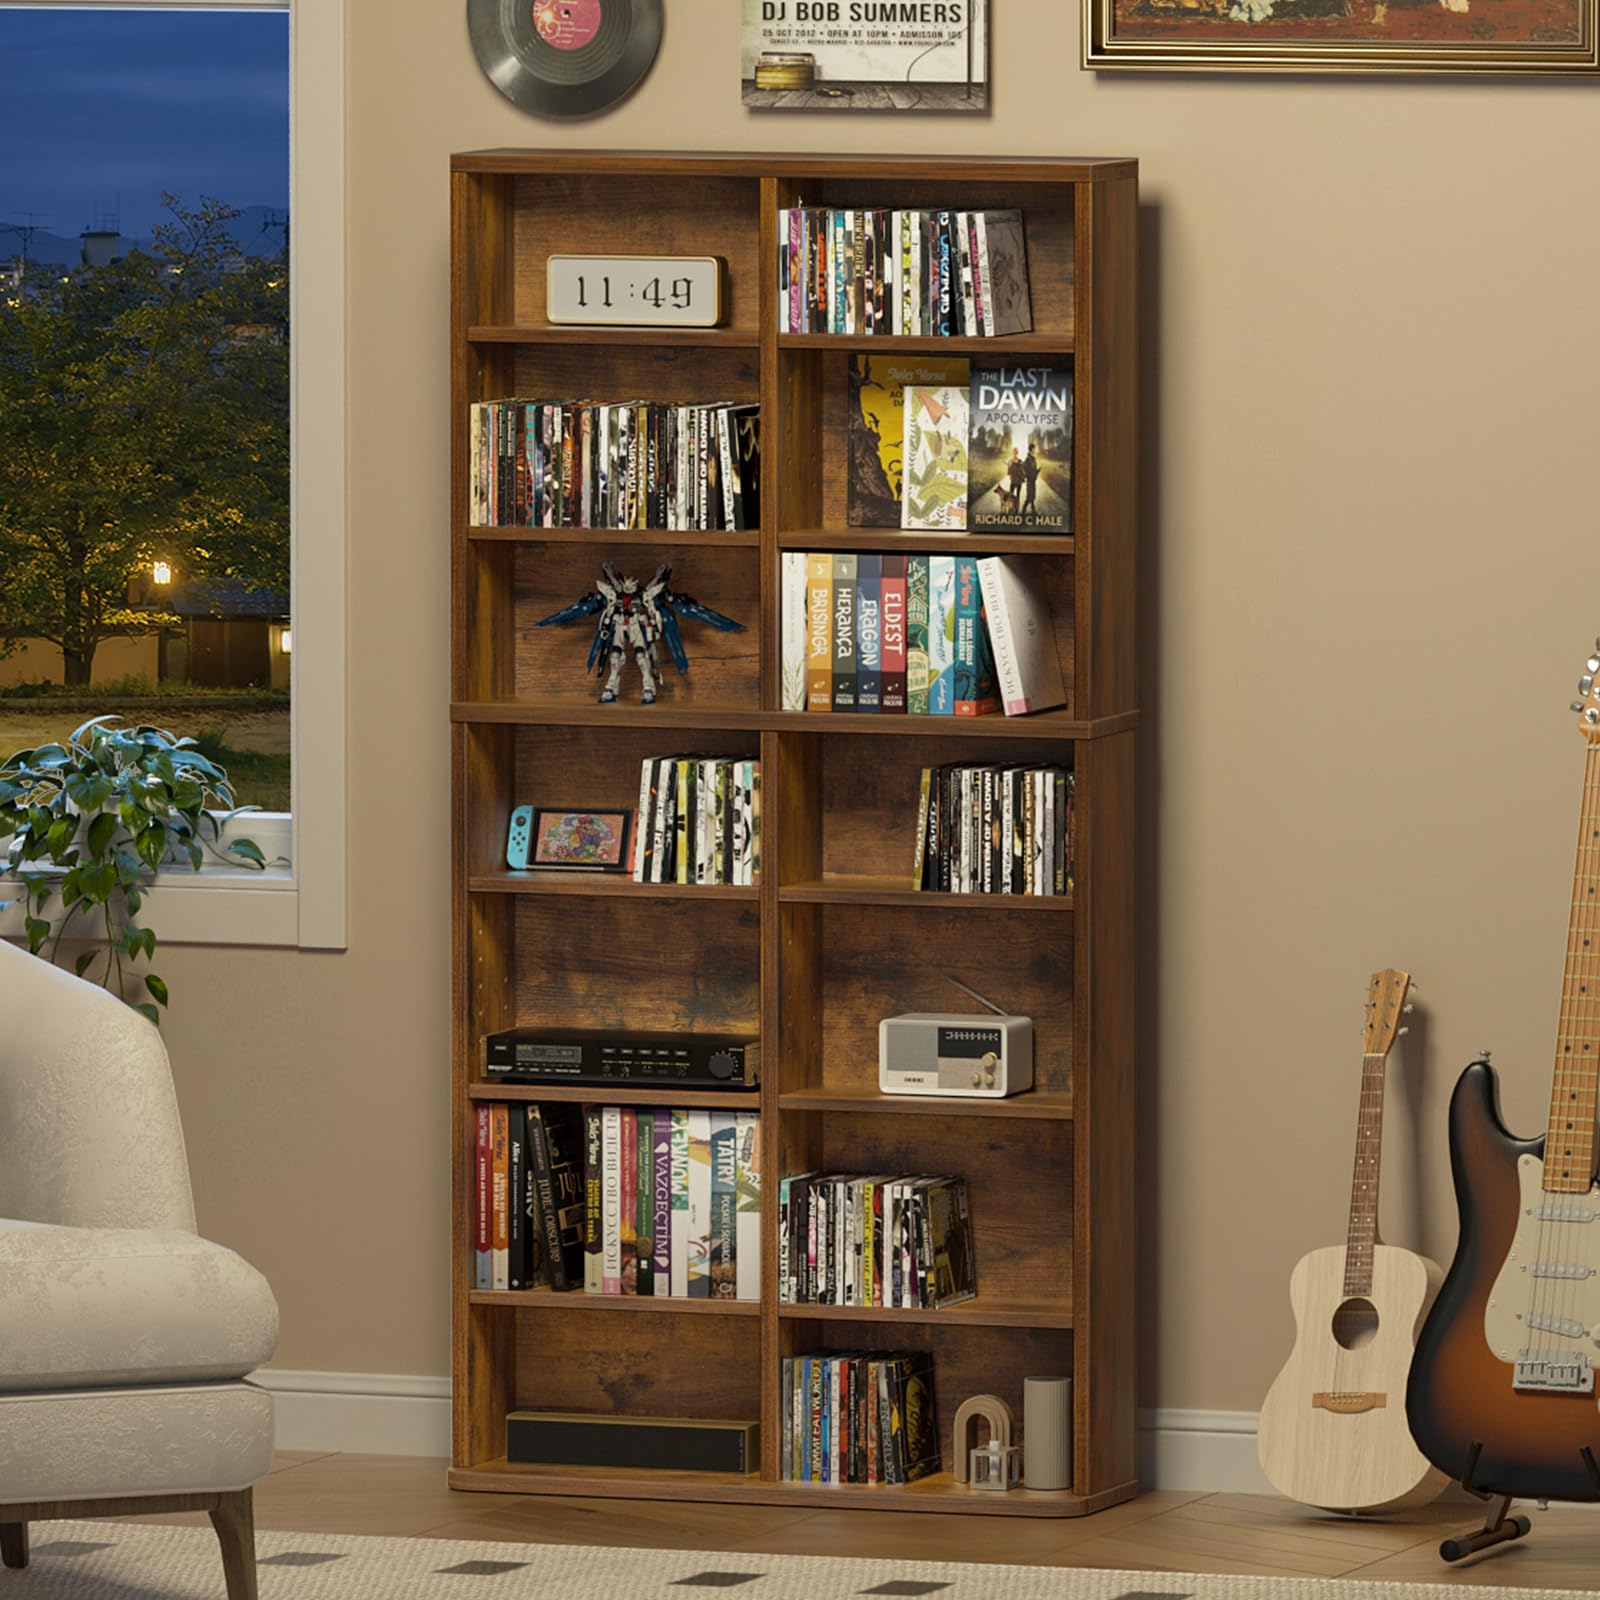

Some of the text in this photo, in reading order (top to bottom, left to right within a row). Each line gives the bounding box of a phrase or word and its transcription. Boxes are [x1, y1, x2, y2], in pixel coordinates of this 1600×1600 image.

[762, 2, 962, 23] DJ BOB SUMMERS
[776, 29, 791, 37] OCT
[795, 29, 816, 37] 2012
[827, 29, 848, 38] OPEN
[852, 30, 862, 38] AT
[867, 30, 888, 38] 10PM
[577, 276, 694, 309] 11:49
[979, 386, 1066, 411] DAWN
[981, 368, 1053, 387] THE LAST
[986, 413, 1059, 425] APOCALYPSE
[700, 410, 708, 530] SYSTEM OF A DOWN
[975, 514, 1063, 527] RICHARD C HALE
[809, 588, 828, 659] BRISINGR
[858, 599, 878, 665] ERAGON
[884, 592, 902, 655] ELDEST
[984, 772, 992, 893] SYSTEM OF A DOWN
[512, 1141, 520, 1163] Alice
[588, 1117, 600, 1165] Jules Verne
[671, 1121, 688, 1195] MONKEY
[717, 1138, 735, 1185] TATRY
[606, 1176, 617, 1270] ИСКУССТВО
[654, 1155, 671, 1255] VAZGEÇTİM
[721, 1195, 731, 1224] POLSKIE
[812, 1366, 821, 1472] JIMMY EAT WORLD
